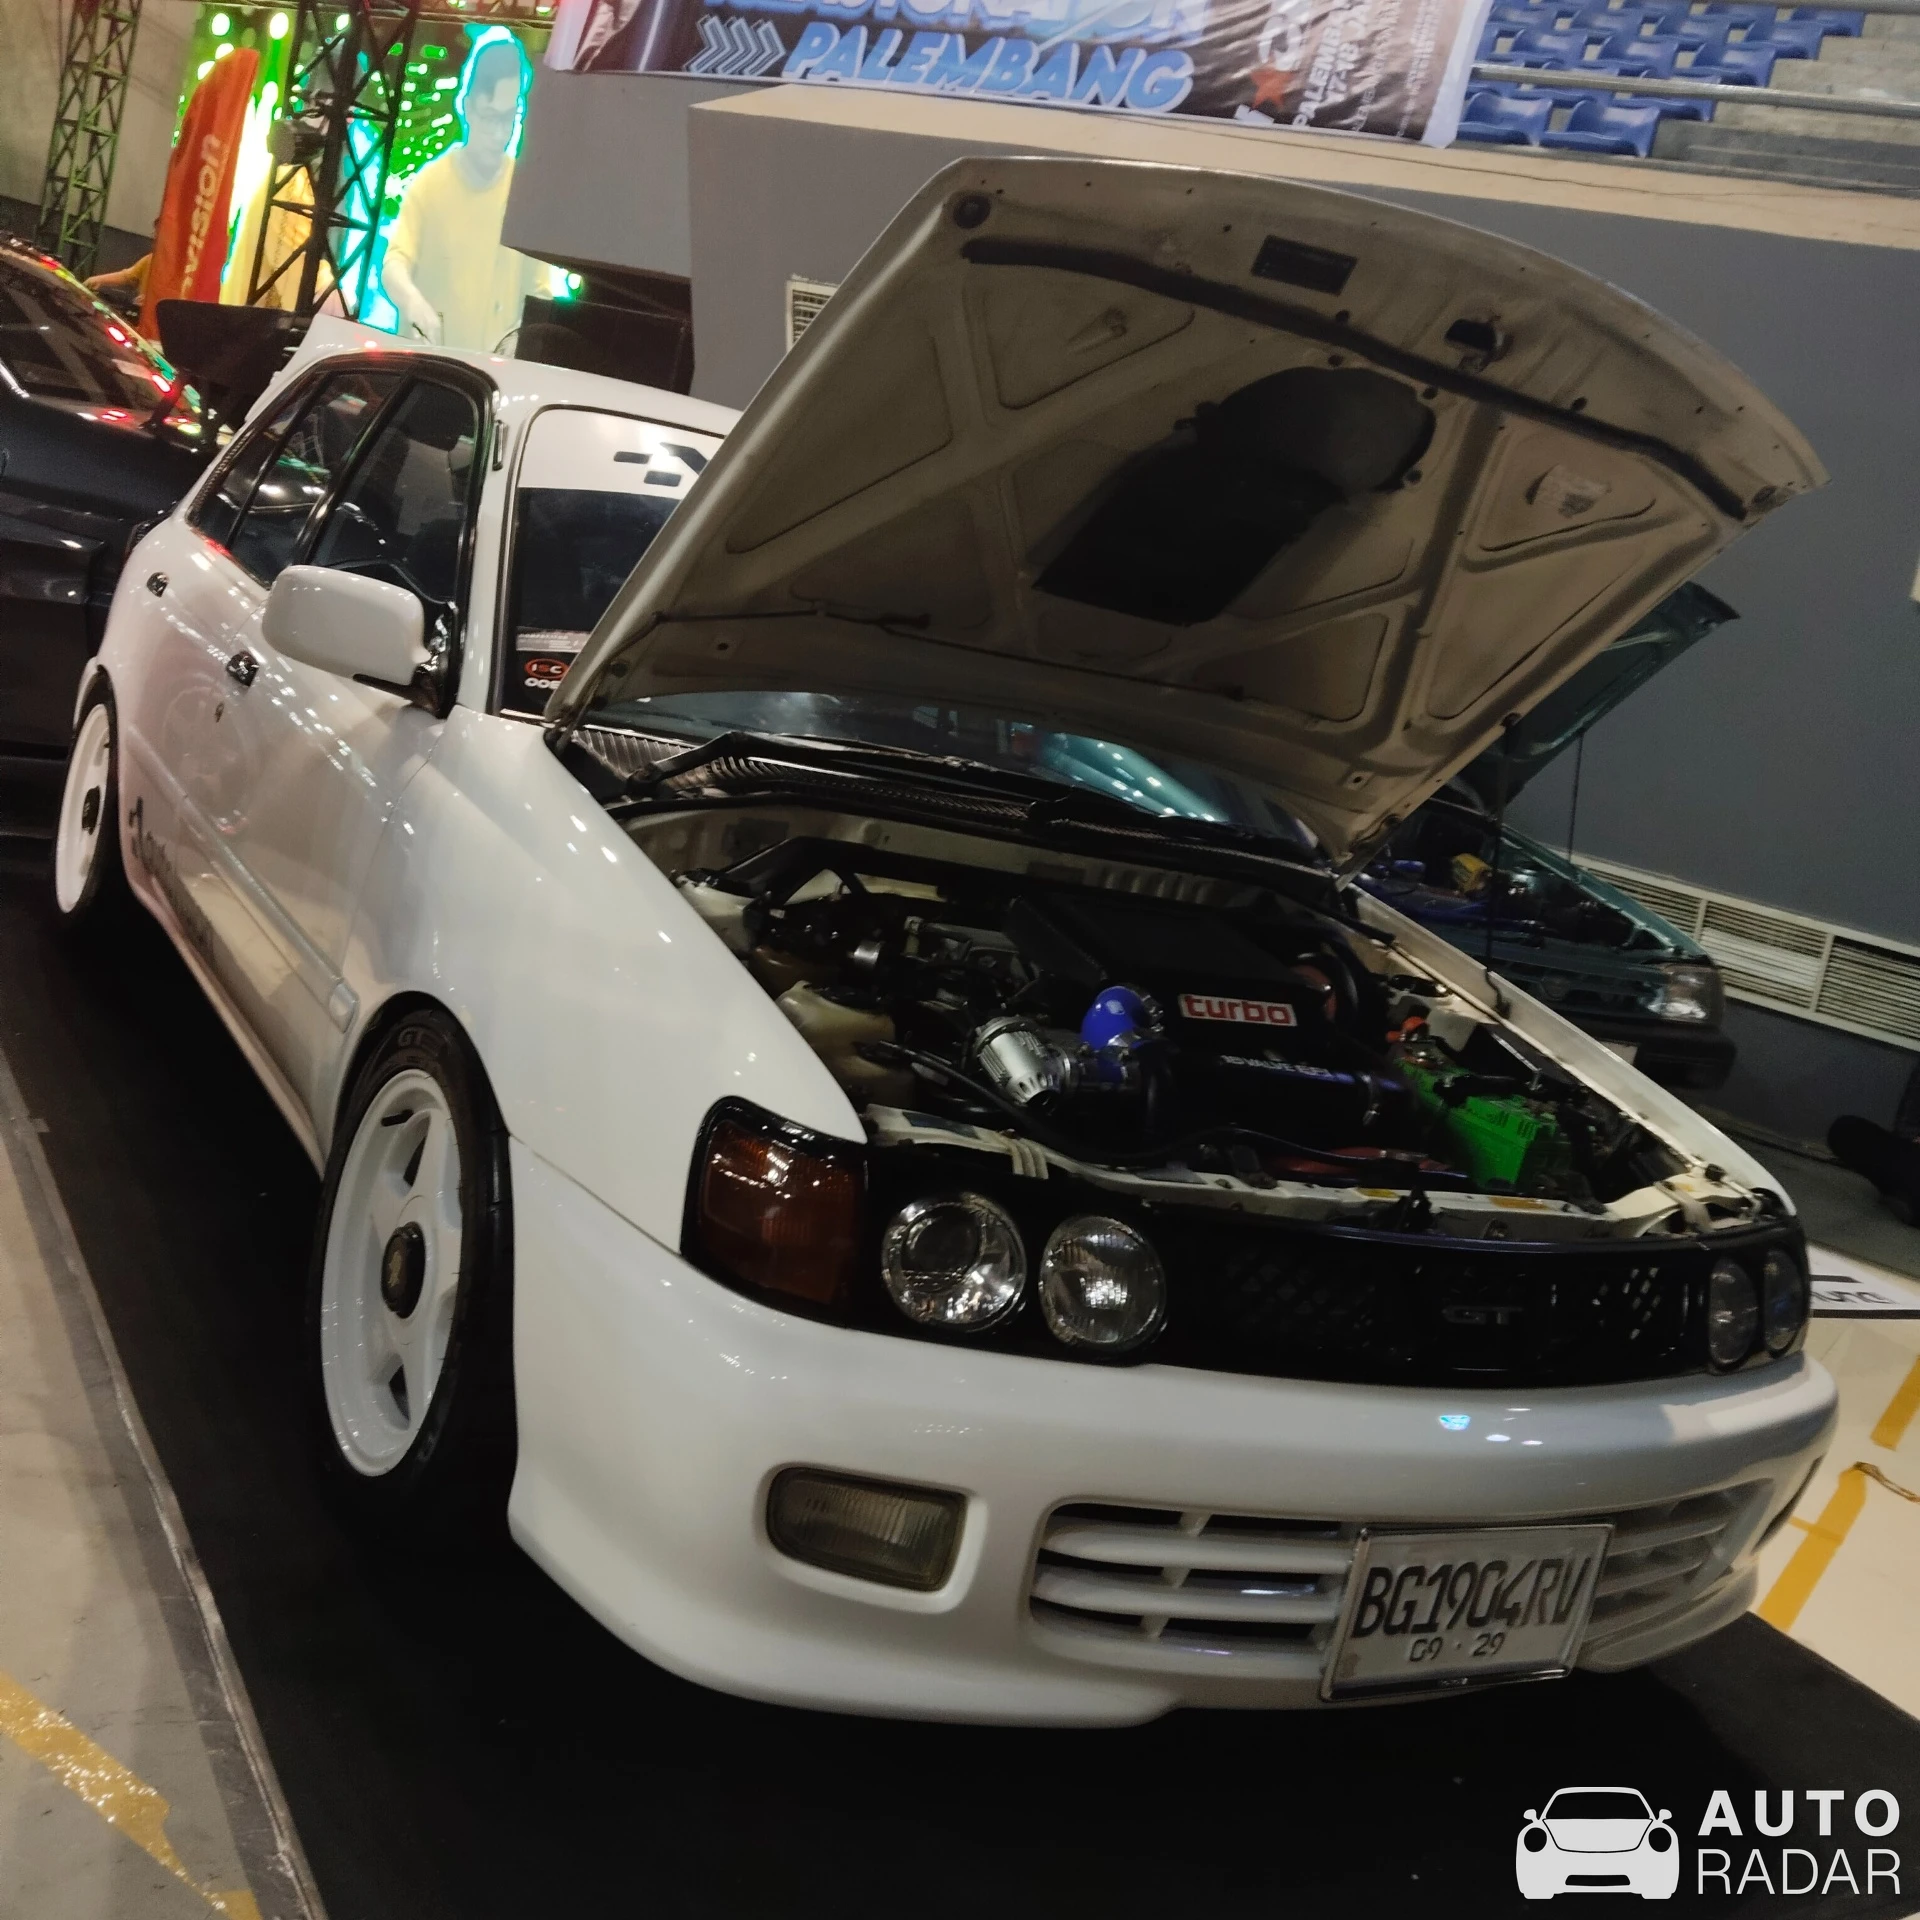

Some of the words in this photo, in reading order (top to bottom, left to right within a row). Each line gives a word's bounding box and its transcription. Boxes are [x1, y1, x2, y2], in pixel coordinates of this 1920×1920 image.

[781, 22, 1197, 113] PALEMBANG
[1184, 995, 1291, 1024] turbo
[1441, 1305, 1524, 1325] GT
